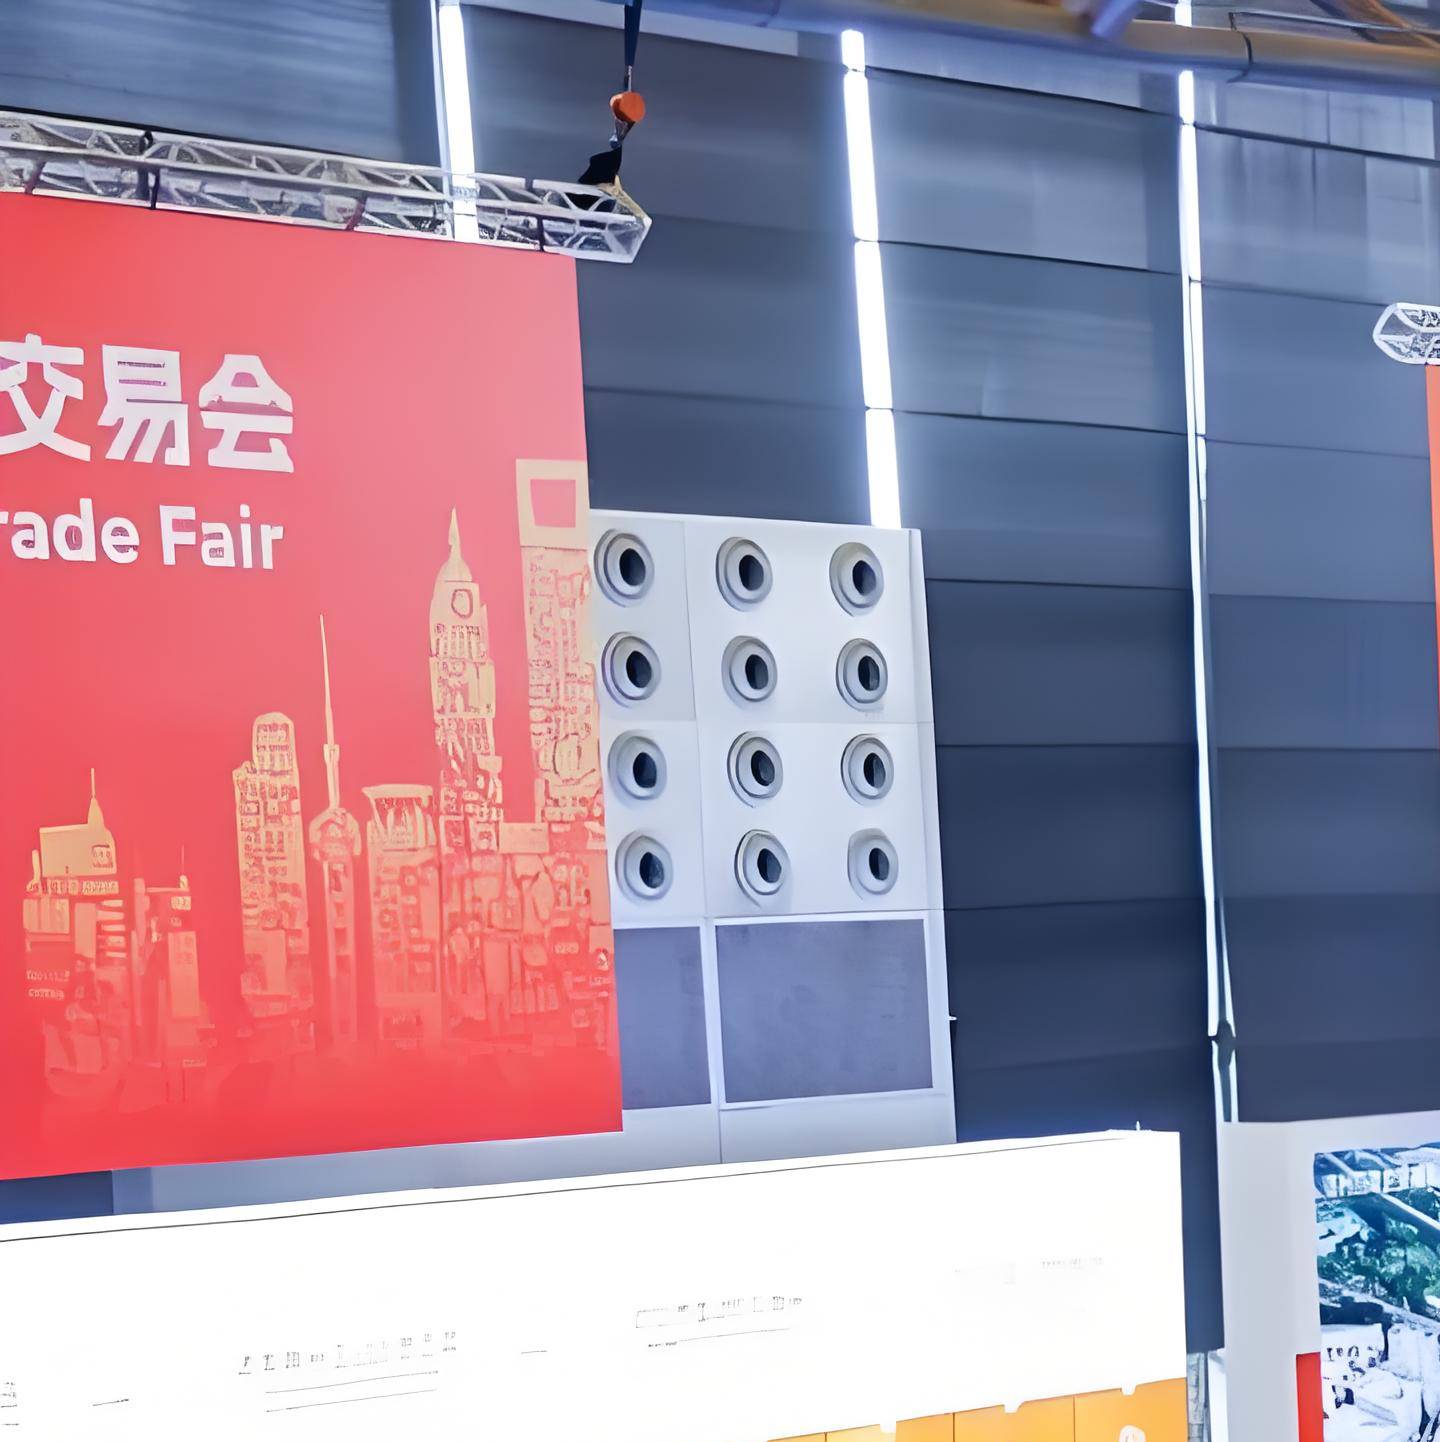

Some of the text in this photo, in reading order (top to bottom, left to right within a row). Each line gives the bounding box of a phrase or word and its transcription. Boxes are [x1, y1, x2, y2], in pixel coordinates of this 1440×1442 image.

[0, 333, 294, 473] 交易会
[159, 504, 284, 570] Fair
